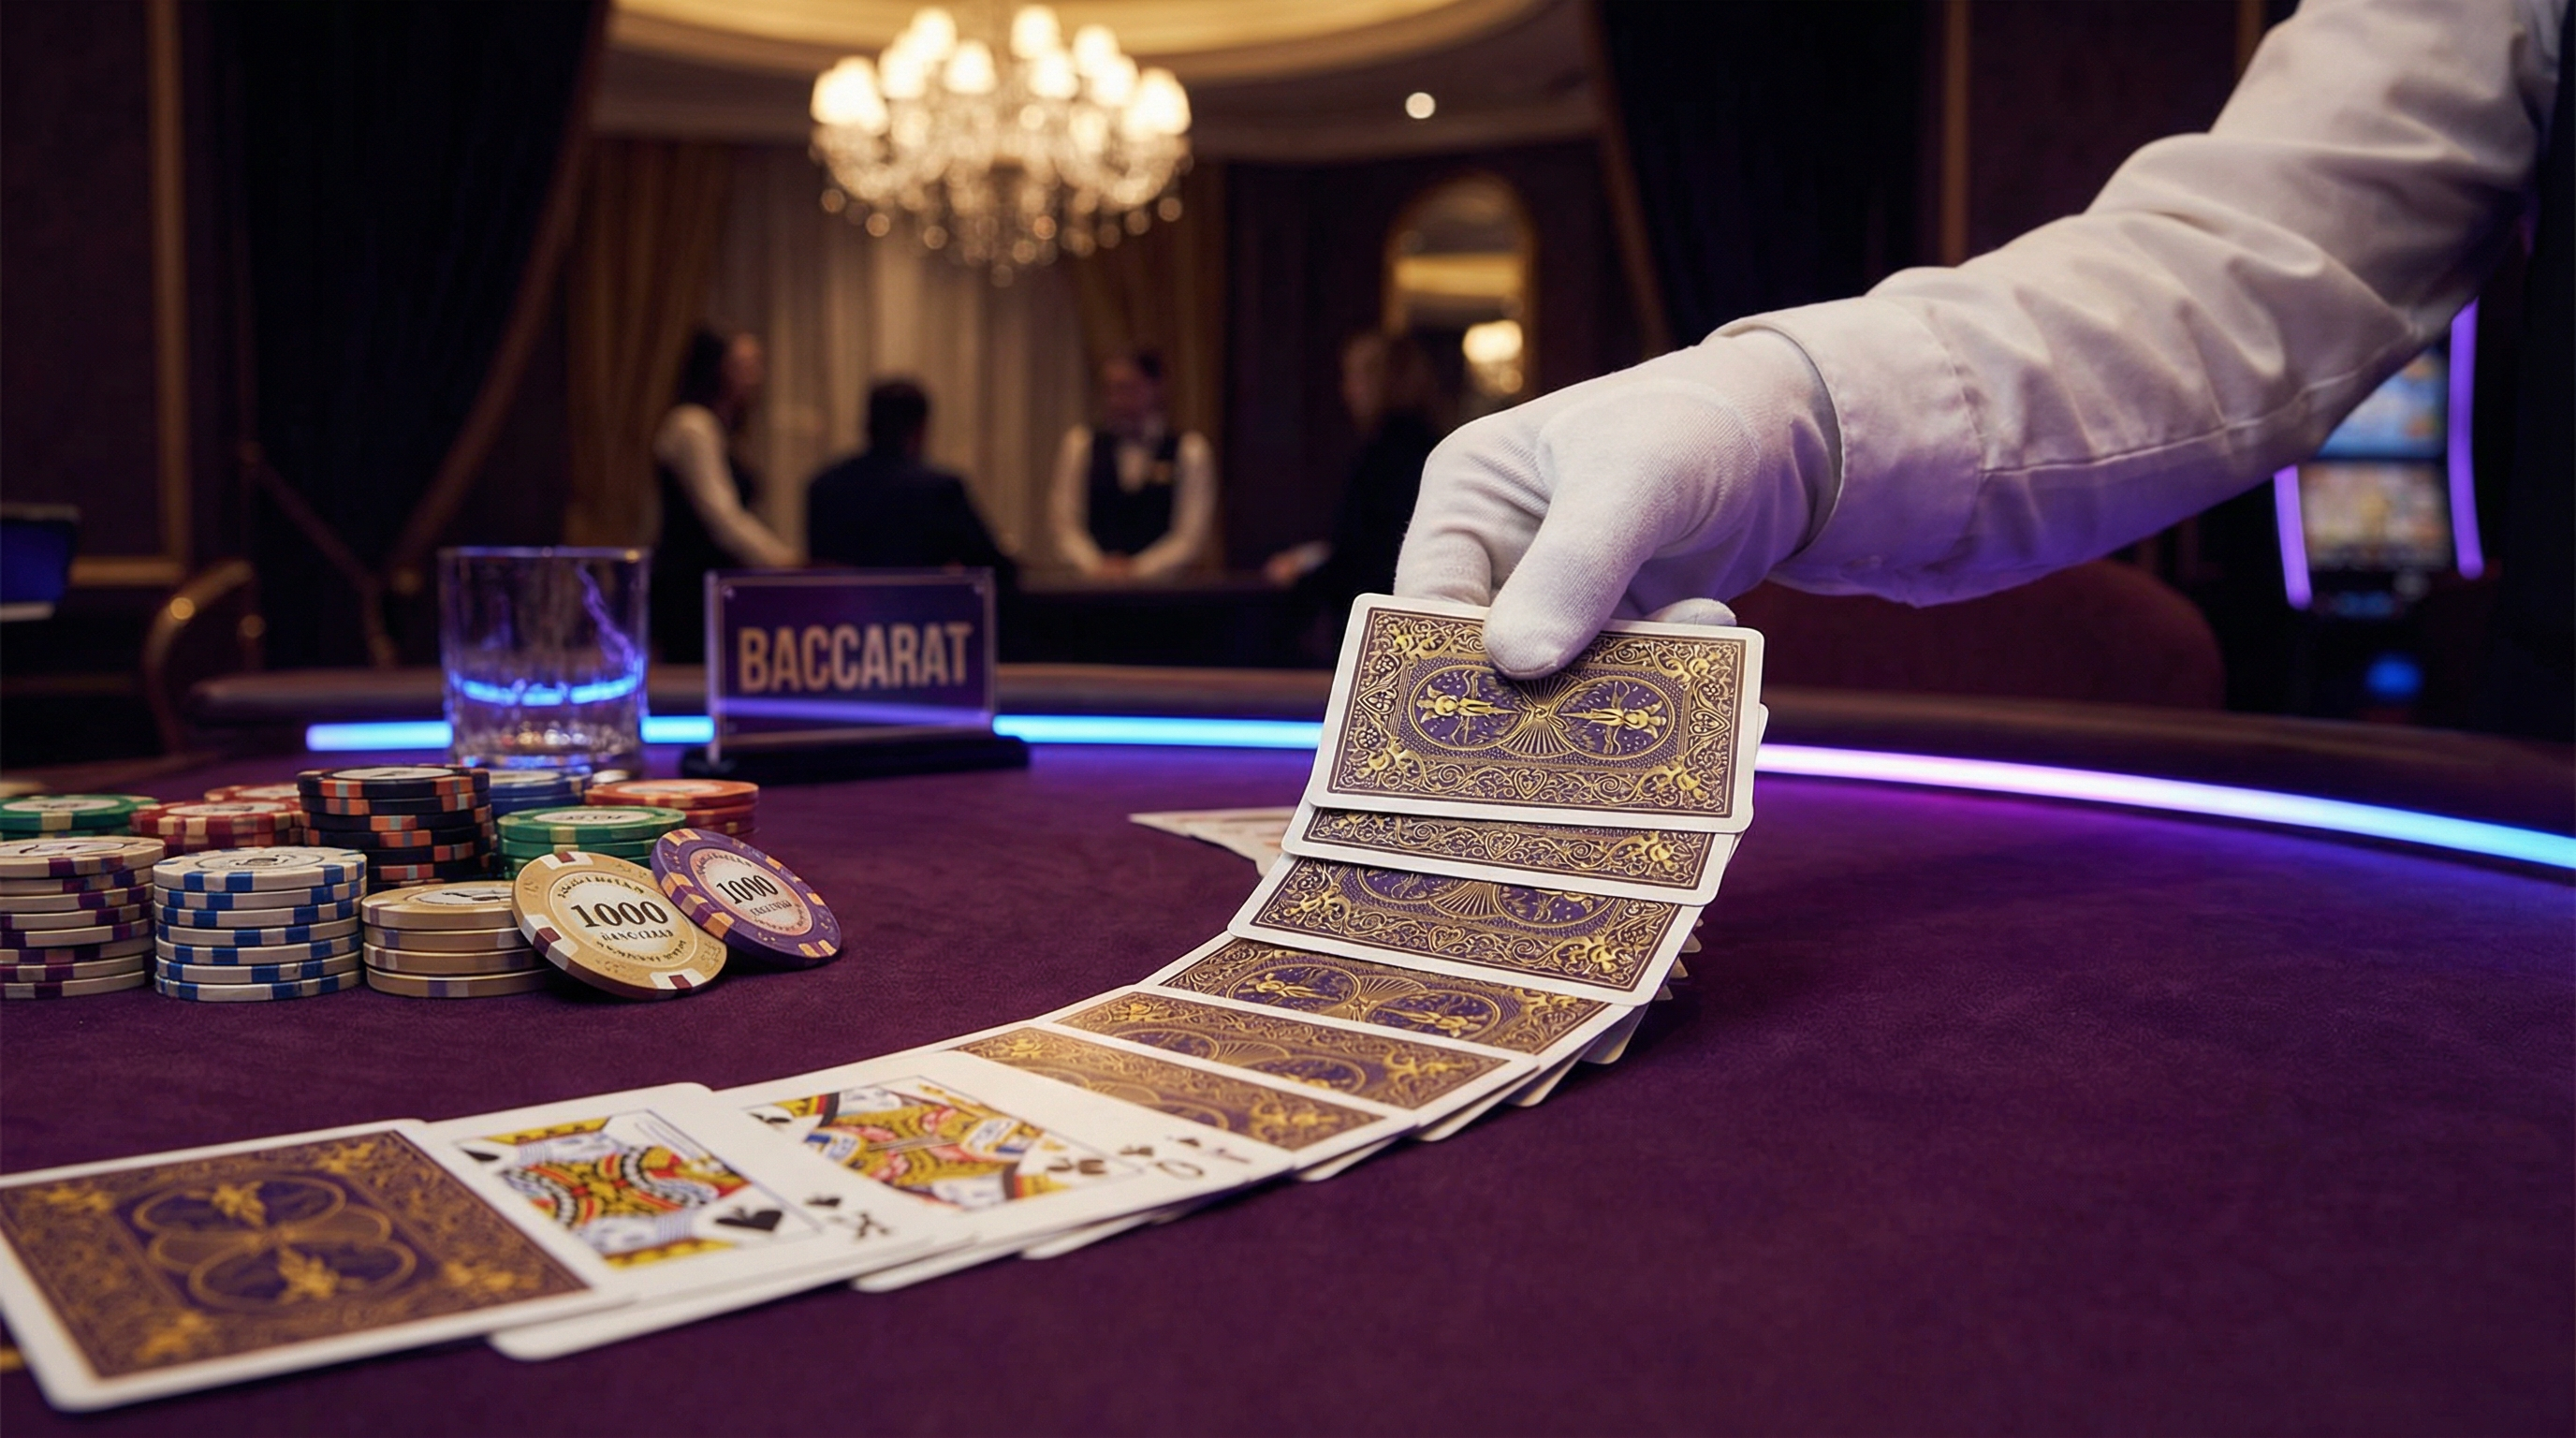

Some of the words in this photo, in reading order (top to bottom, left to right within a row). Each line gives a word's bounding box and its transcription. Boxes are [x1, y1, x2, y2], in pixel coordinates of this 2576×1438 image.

[738, 622, 973, 692] BACCARAT
[716, 874, 779, 904] 1000
[570, 901, 668, 928] 1000
